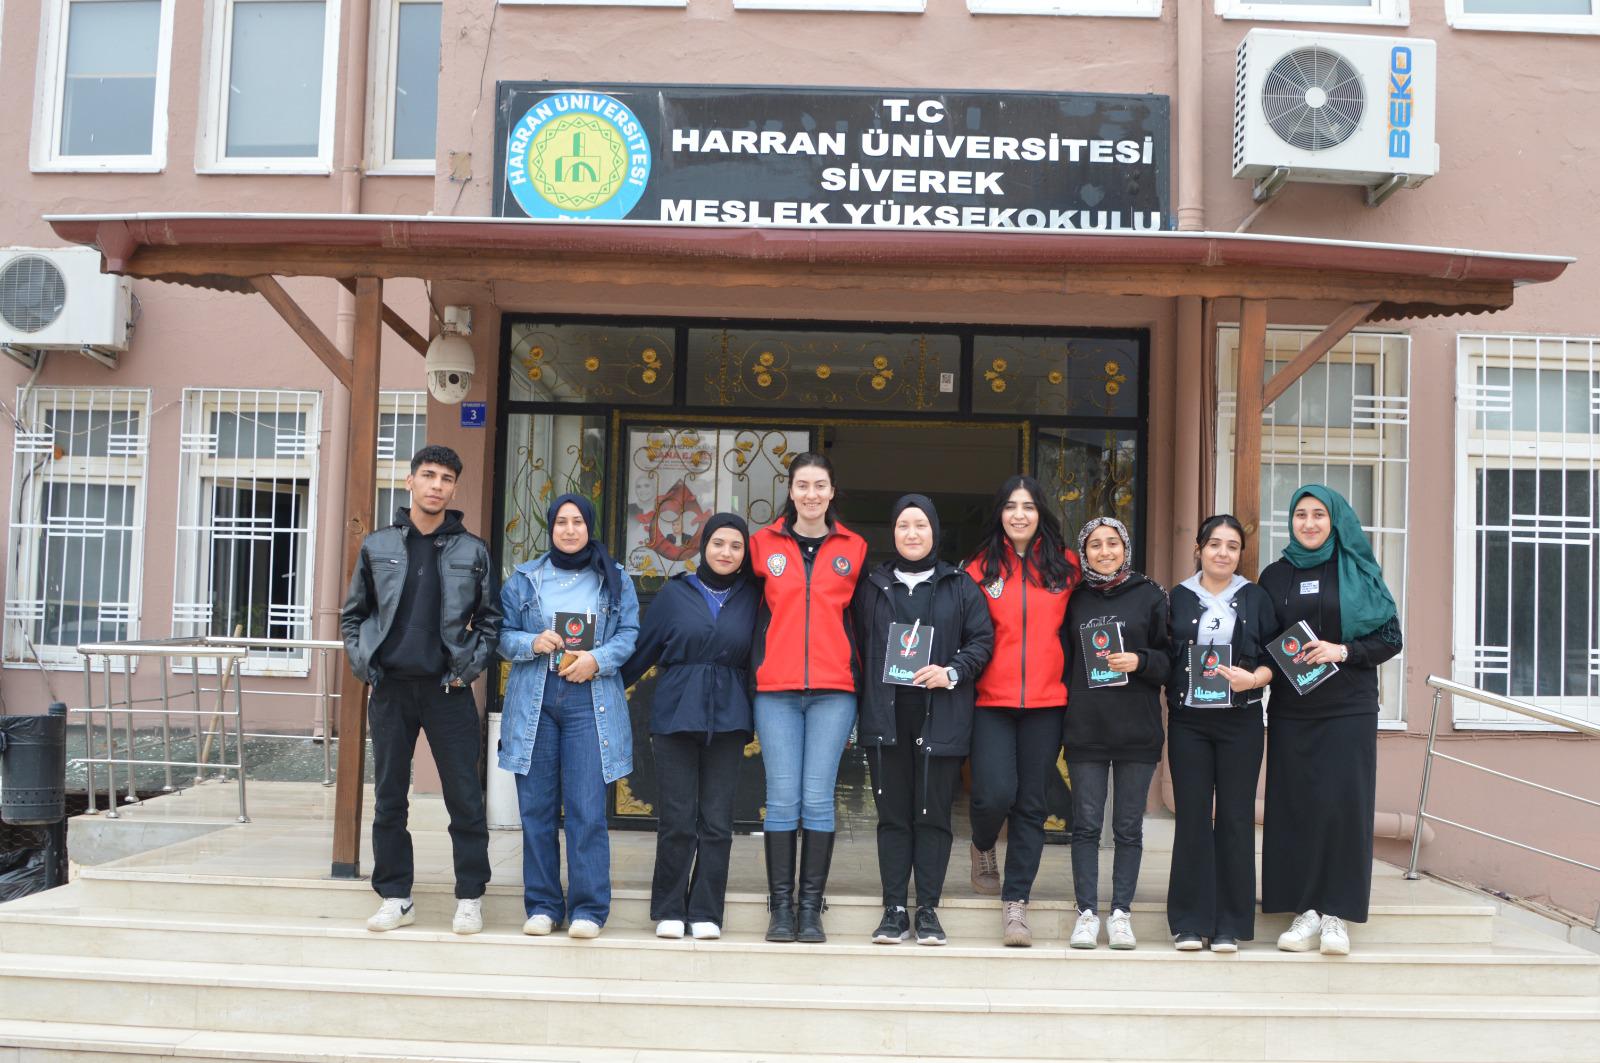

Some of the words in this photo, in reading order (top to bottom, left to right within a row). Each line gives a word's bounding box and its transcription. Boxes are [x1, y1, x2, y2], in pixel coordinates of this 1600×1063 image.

[883, 99, 945, 123] T.C
[1389, 46, 1412, 158] BEKO
[509, 103, 553, 185] HARRAN
[672, 129, 846, 156] HARRAN
[861, 128, 1153, 165] ÜNİVERSİTESİ
[820, 162, 1005, 195] SİVEREK
[660, 199, 830, 224] MESLEK
[842, 199, 1161, 231] YÜKSEKOKULU
[470, 409, 477, 420] 3
